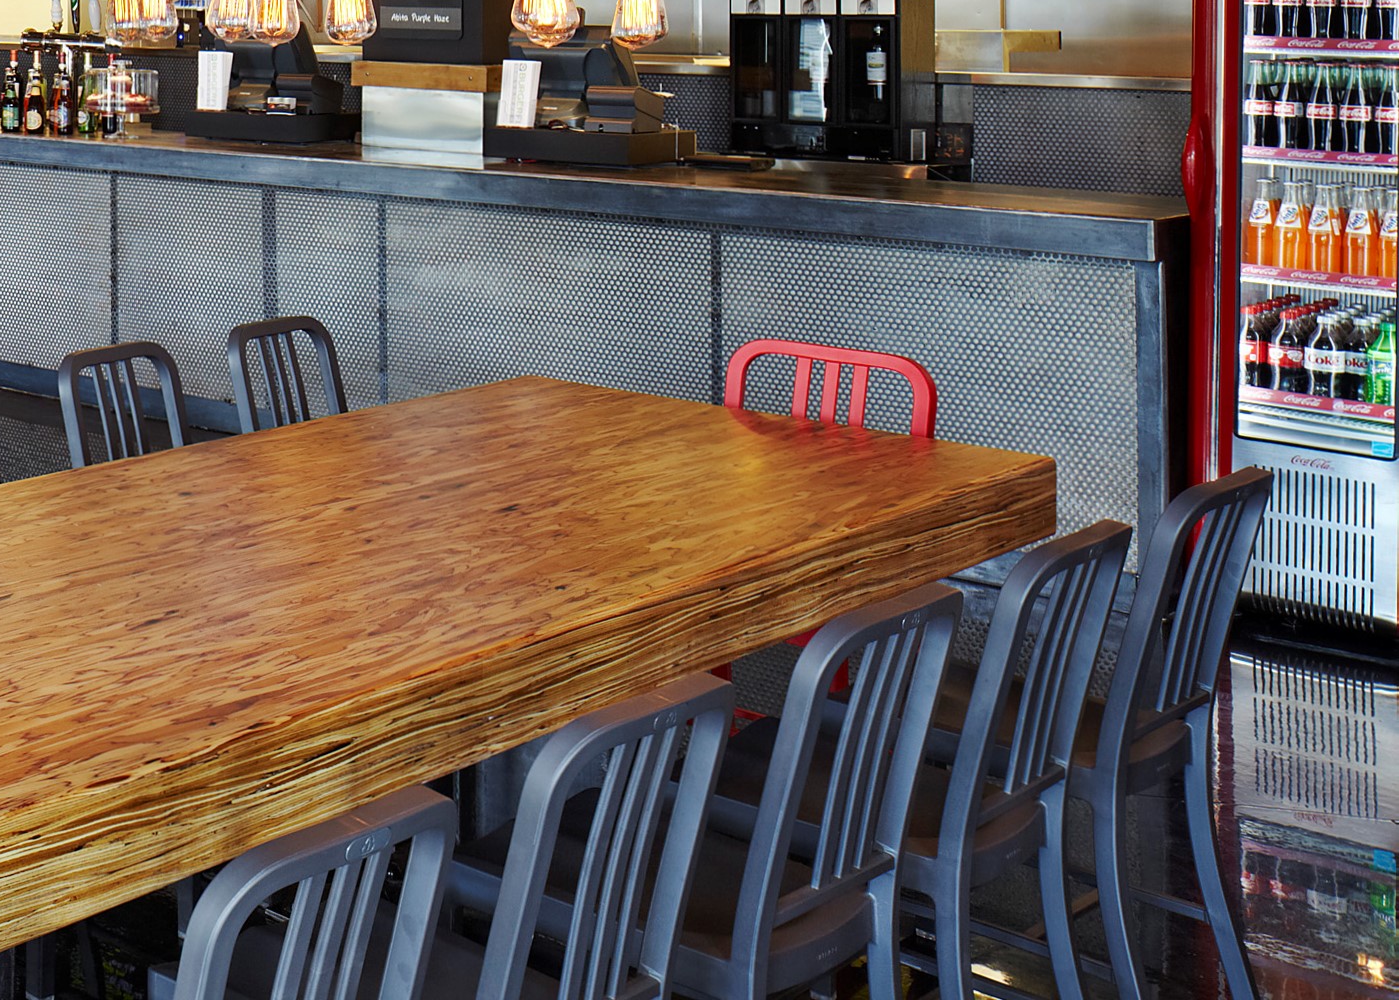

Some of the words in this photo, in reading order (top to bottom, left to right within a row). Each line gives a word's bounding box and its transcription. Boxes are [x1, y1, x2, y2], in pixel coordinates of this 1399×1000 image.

[391, 13, 408, 22] Abita
[412, 13, 431, 23] Purple
[434, 14, 449, 23] Haze
[1308, 354, 1339, 365] Coke
[1345, 360, 1368, 368] oke
[1291, 455, 1330, 470] Coca-Cola
